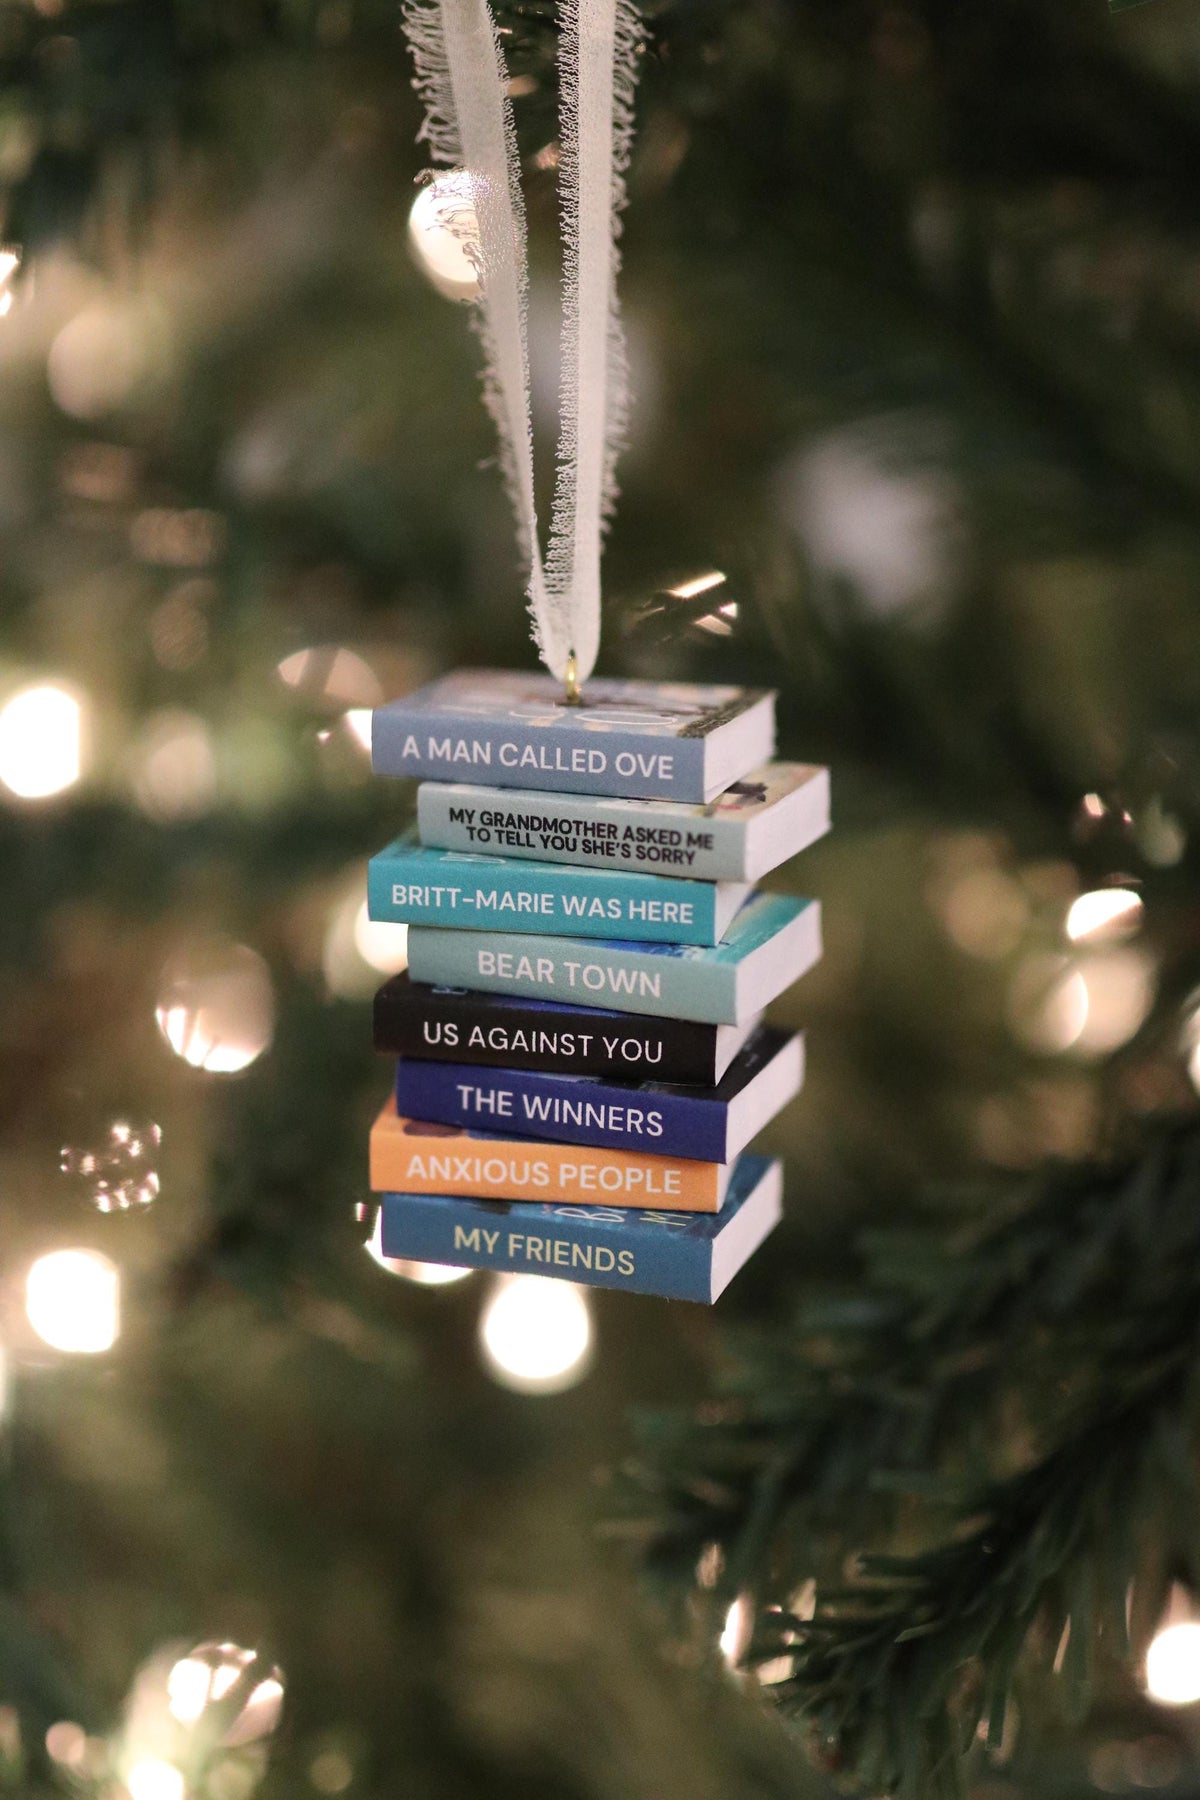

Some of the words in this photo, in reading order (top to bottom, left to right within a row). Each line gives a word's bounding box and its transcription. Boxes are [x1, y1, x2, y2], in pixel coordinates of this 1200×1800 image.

[402, 736, 420, 758] A
[429, 739, 491, 764] MAN
[500, 744, 606, 773] CALLED
[615, 753, 674, 780] OVE
[449, 807, 477, 824] MY
[480, 810, 618, 840] GRANDMOTHER
[623, 825, 681, 846] ASKED
[687, 832, 714, 850] ME
[466, 826, 491, 842] TO
[495, 828, 536, 848] TELL
[540, 833, 577, 853] YOU
[582, 839, 631, 858] SHE'S
[635, 844, 696, 865] SORRY
[392, 885, 554, 914] BRITT-MARIE
[561, 895, 622, 919] WAS
[629, 900, 694, 924] HERE
[478, 951, 554, 984] BEAR
[564, 962, 661, 998] TOWN
[423, 1021, 458, 1046] US
[468, 1026, 593, 1057] AGAINST
[602, 1036, 663, 1063] YOU
[457, 1085, 513, 1116] THE
[523, 1095, 663, 1136] WINNERS
[407, 1155, 549, 1186] ANXIOUS
[559, 1163, 681, 1194] PEOPLE
[454, 1225, 500, 1254] MY
[508, 1234, 634, 1275] FRIENDS
